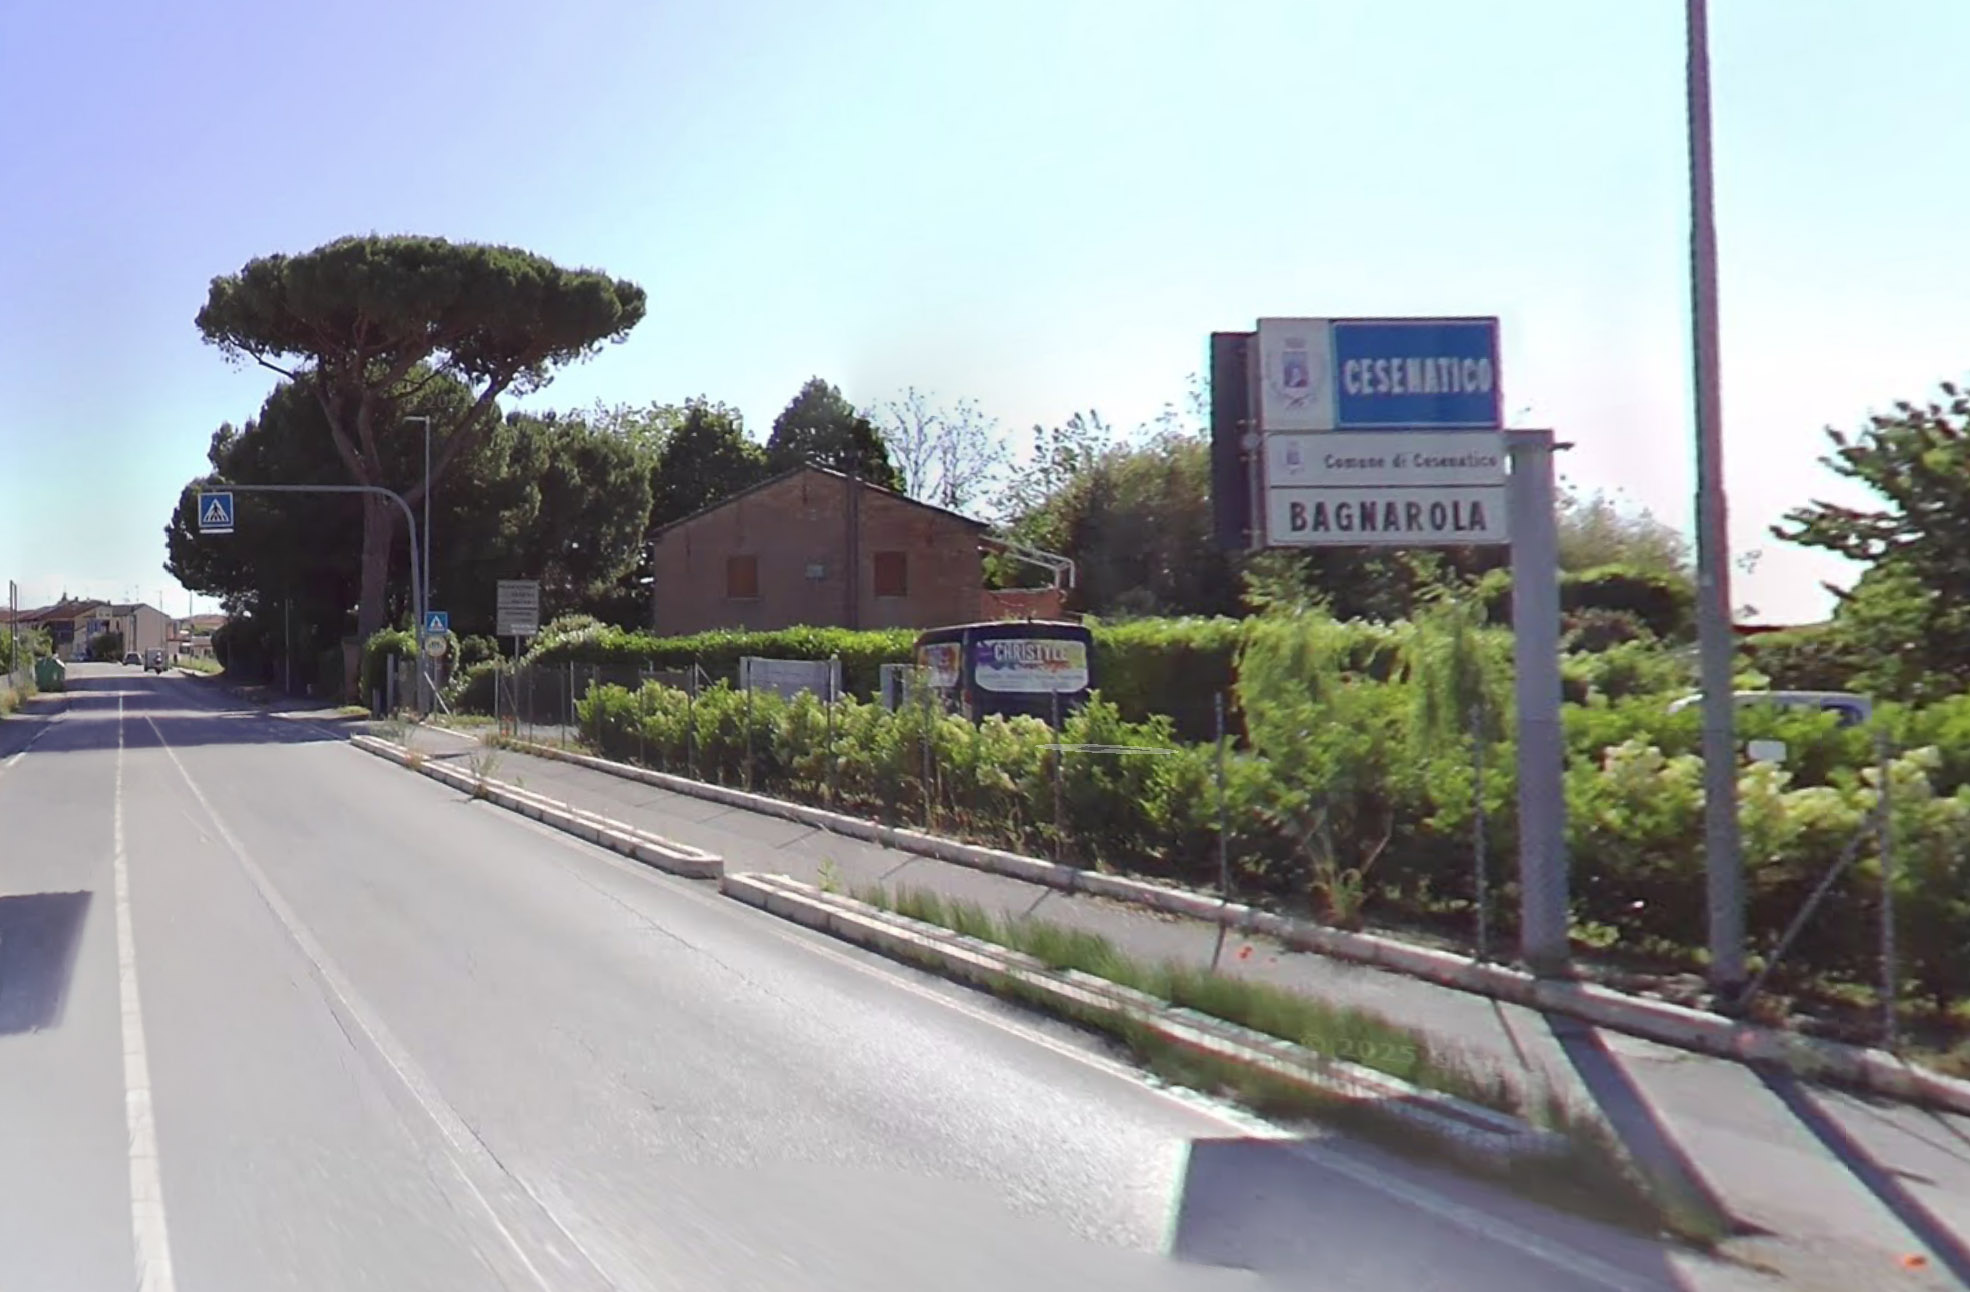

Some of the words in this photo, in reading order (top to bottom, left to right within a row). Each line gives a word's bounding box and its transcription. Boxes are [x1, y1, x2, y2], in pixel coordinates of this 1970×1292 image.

[1344, 356, 1492, 395] CESENATICO
[1324, 452, 1386, 469] Comune
[1391, 452, 1408, 469] di
[1412, 450, 1498, 468] Cesenatico
[1289, 500, 1487, 532] BAGNAROLA
